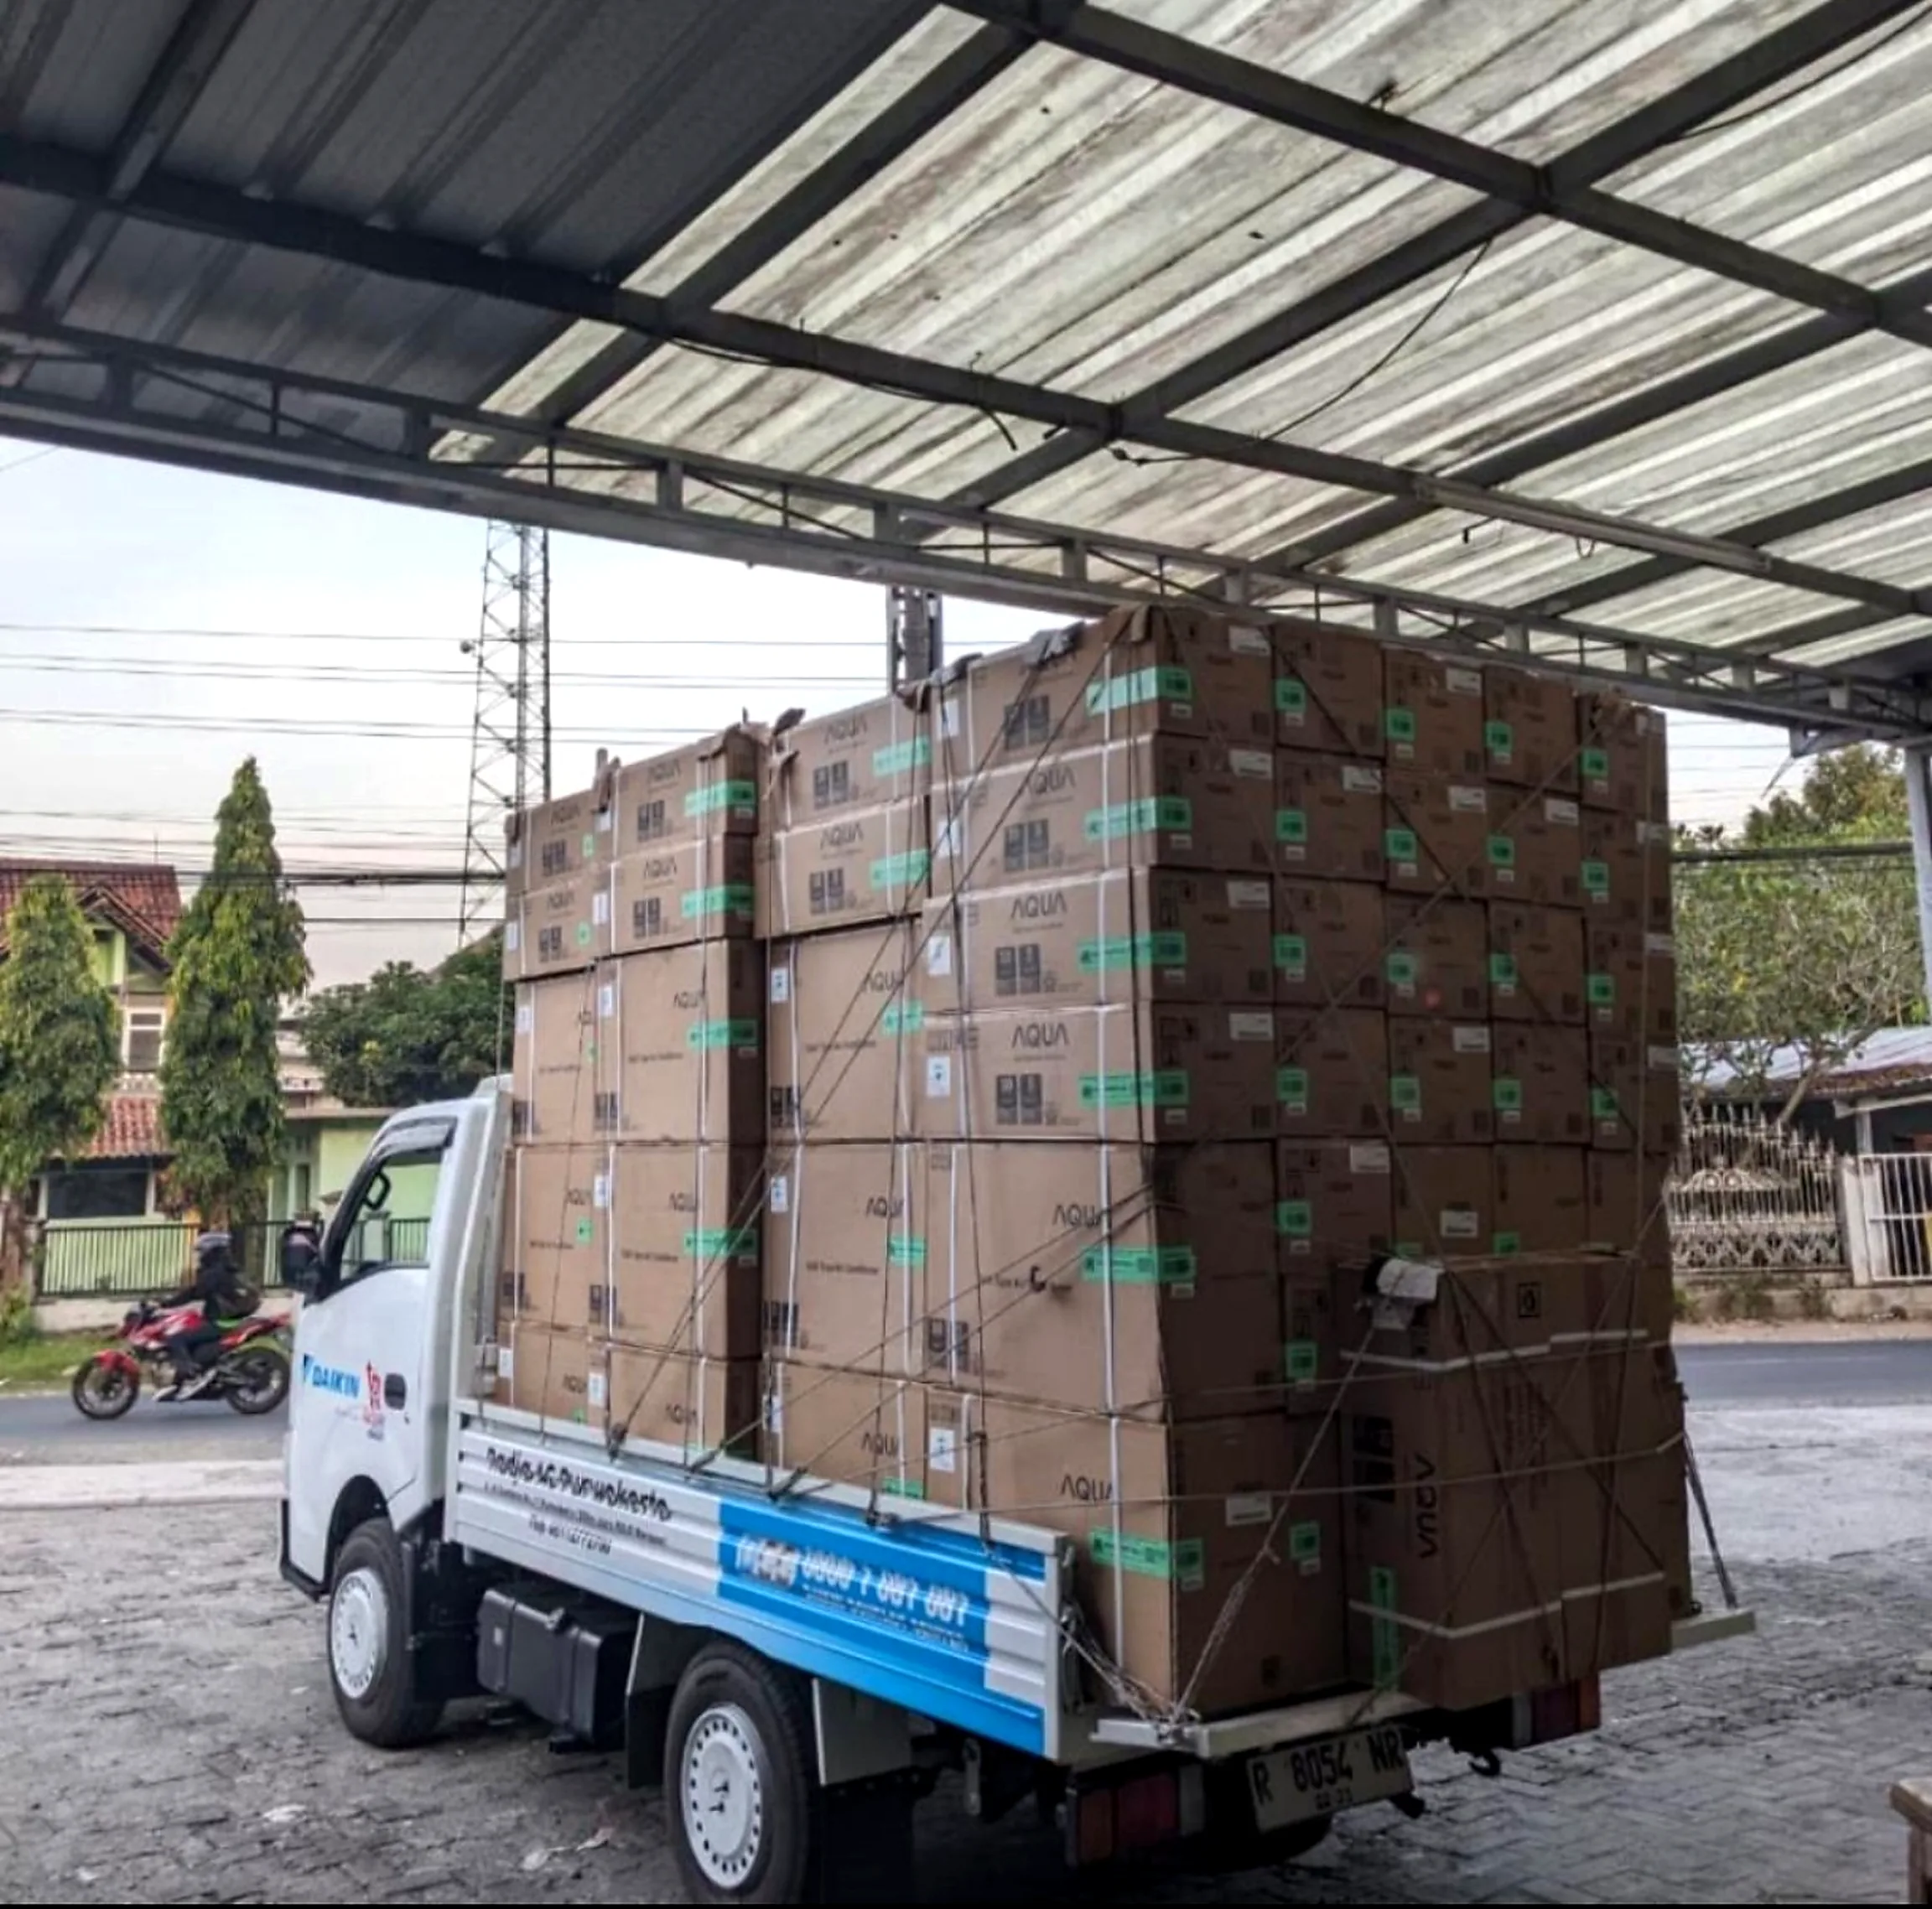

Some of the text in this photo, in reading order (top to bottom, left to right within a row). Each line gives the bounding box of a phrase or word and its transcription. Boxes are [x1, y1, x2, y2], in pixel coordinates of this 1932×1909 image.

[823, 719, 868, 742] AQUA
[820, 826, 864, 849] AQUA
[643, 857, 677, 879] AQUA
[1010, 892, 1067, 920] AQUA
[1011, 1023, 1069, 1048] AQUA
[865, 1196, 905, 1216] AQU
[313, 1365, 359, 1398] DAIKIN
[861, 1433, 899, 1456] AQU
[1415, 1451, 1438, 1559] AQUA
[1253, 1761, 1273, 1804] R
